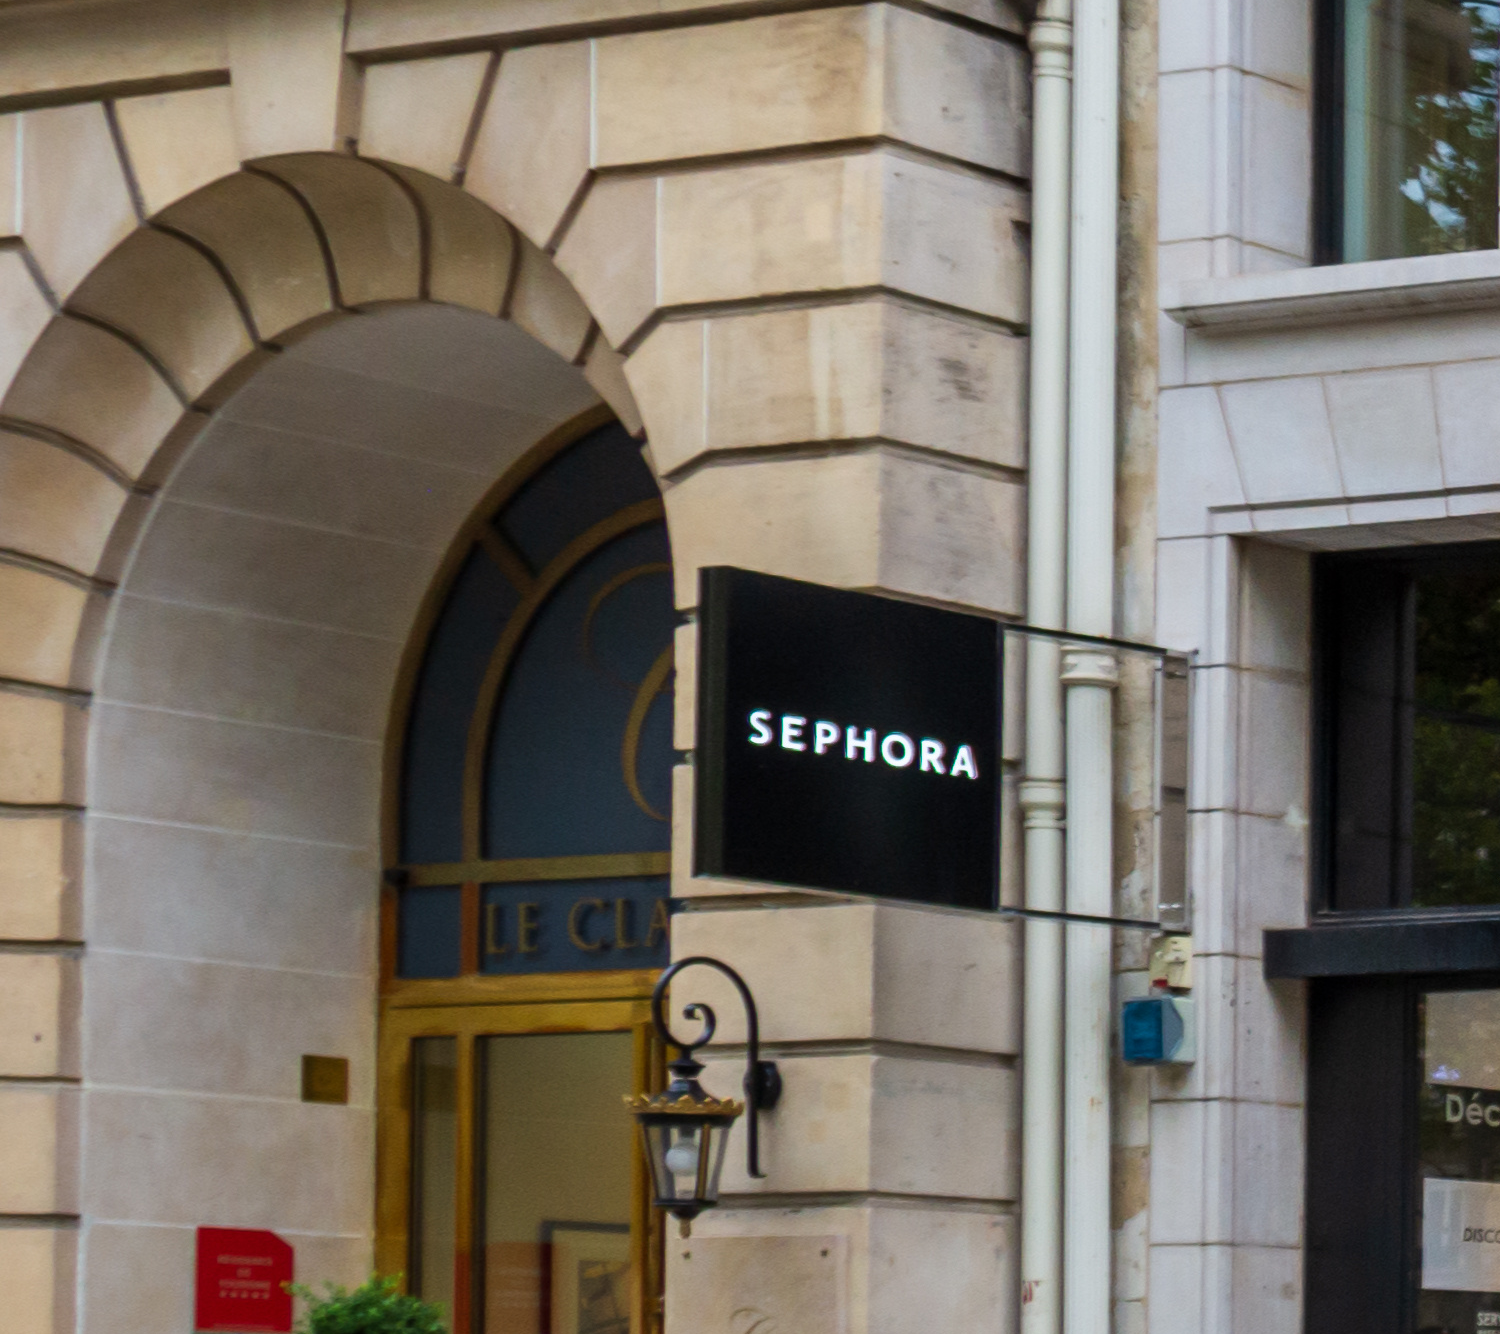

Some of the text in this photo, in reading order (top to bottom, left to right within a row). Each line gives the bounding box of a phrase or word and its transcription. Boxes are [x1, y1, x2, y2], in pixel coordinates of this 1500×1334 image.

[748, 708, 978, 779] SEPHORA
[486, 897, 669, 954] LE CLA
